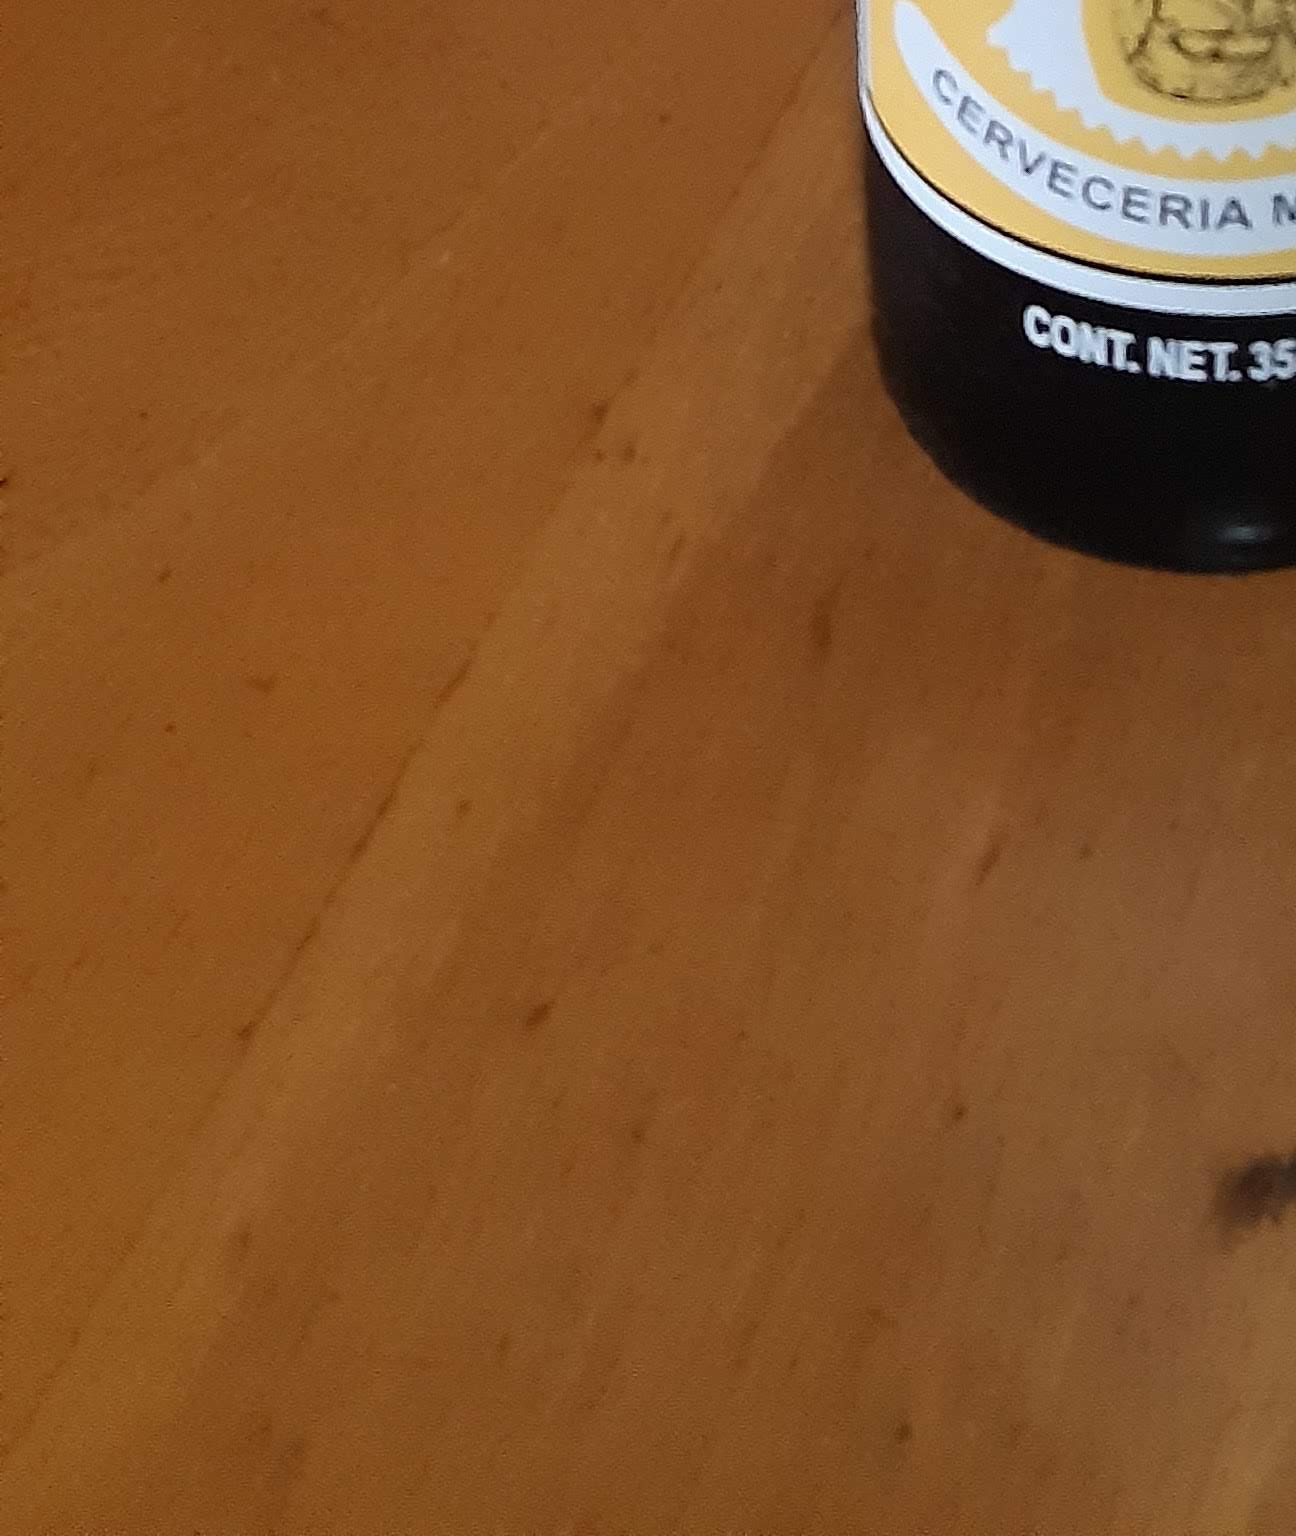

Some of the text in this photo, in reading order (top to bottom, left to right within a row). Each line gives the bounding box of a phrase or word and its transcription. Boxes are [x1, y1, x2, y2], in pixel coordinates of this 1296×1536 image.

[931, 66, 1254, 231] CERVECERIA
[1022, 304, 1141, 374] CONT.
[1146, 335, 1242, 382] NET.
